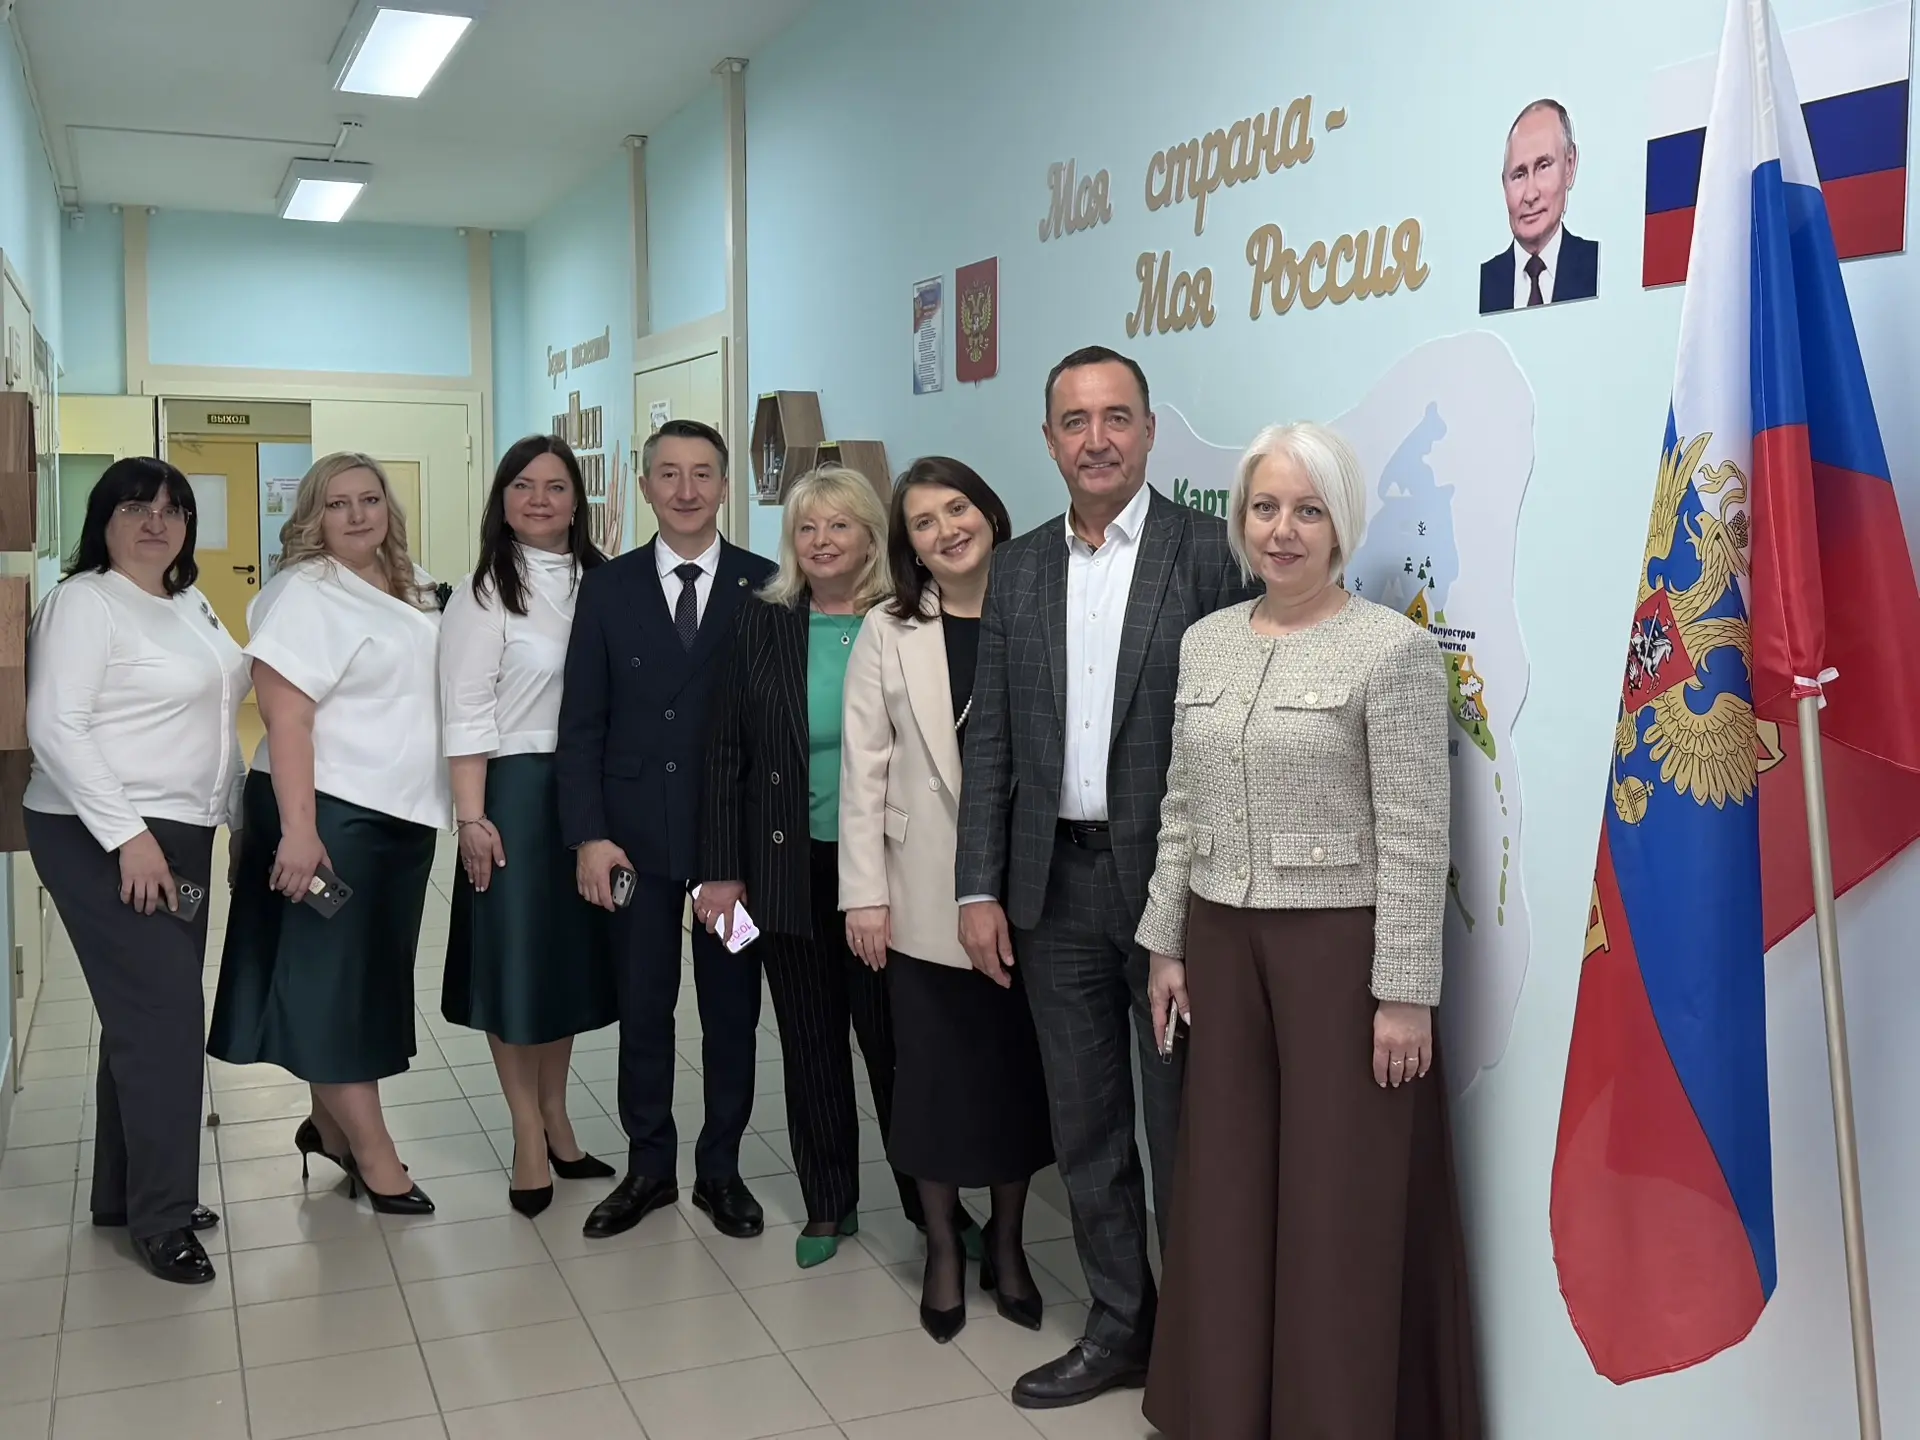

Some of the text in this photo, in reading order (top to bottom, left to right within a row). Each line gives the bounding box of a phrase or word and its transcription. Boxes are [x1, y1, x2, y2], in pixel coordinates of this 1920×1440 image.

[1038, 157, 1113, 242] Моя
[1126, 217, 1431, 338] Моя Россия
[210, 415, 246, 424] ВЫХОД
[1173, 478, 1230, 518] Карт
[1427, 623, 1476, 640] Полуостров
[729, 921, 752, 944] 10:0
